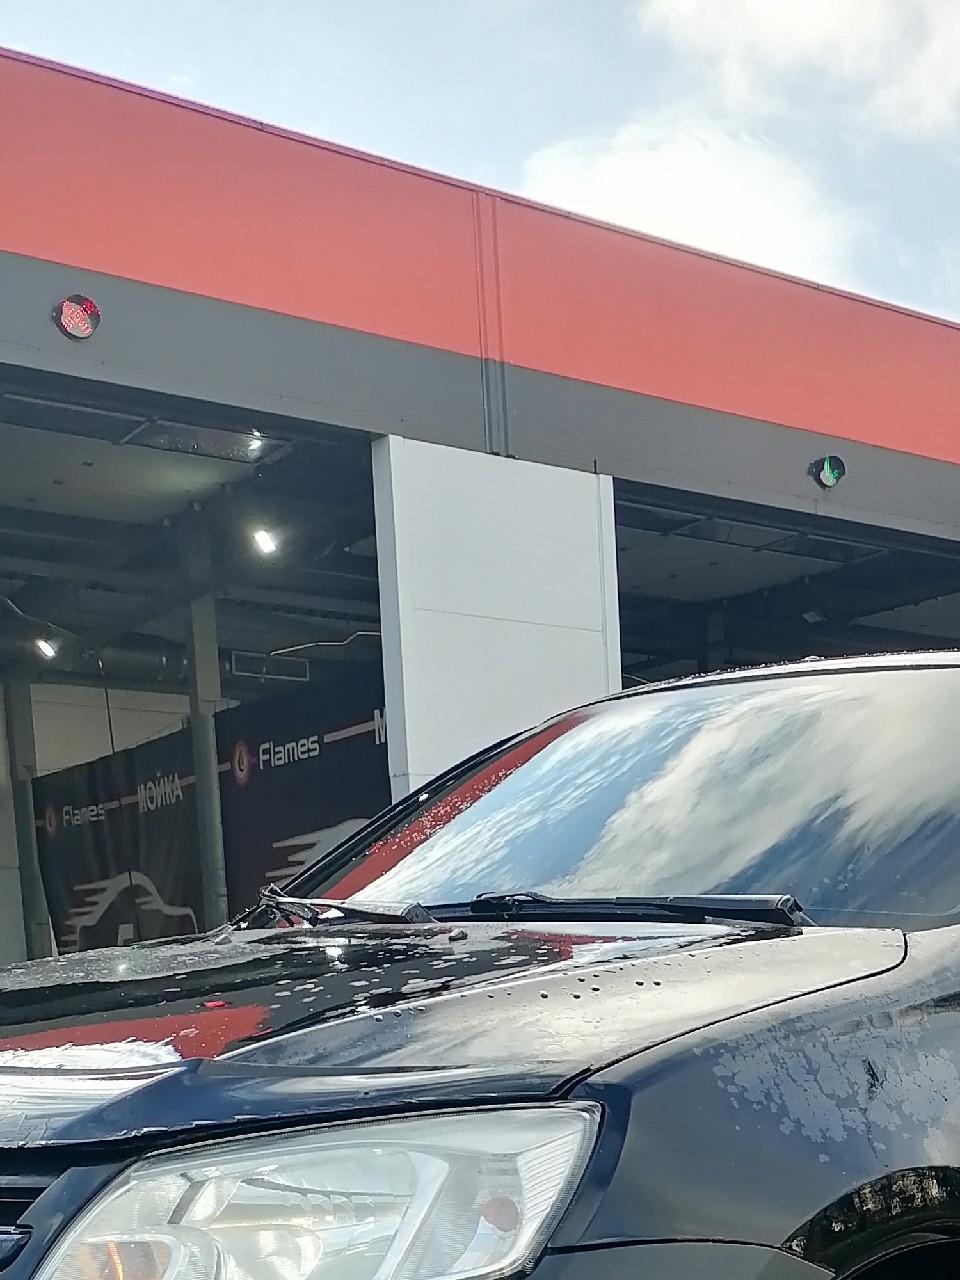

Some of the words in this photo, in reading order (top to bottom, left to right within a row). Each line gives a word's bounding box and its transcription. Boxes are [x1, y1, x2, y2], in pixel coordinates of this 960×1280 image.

[259, 735, 320, 770] Flames
[137, 769, 183, 814] МОЙКА
[62, 802, 105, 828] Flames
